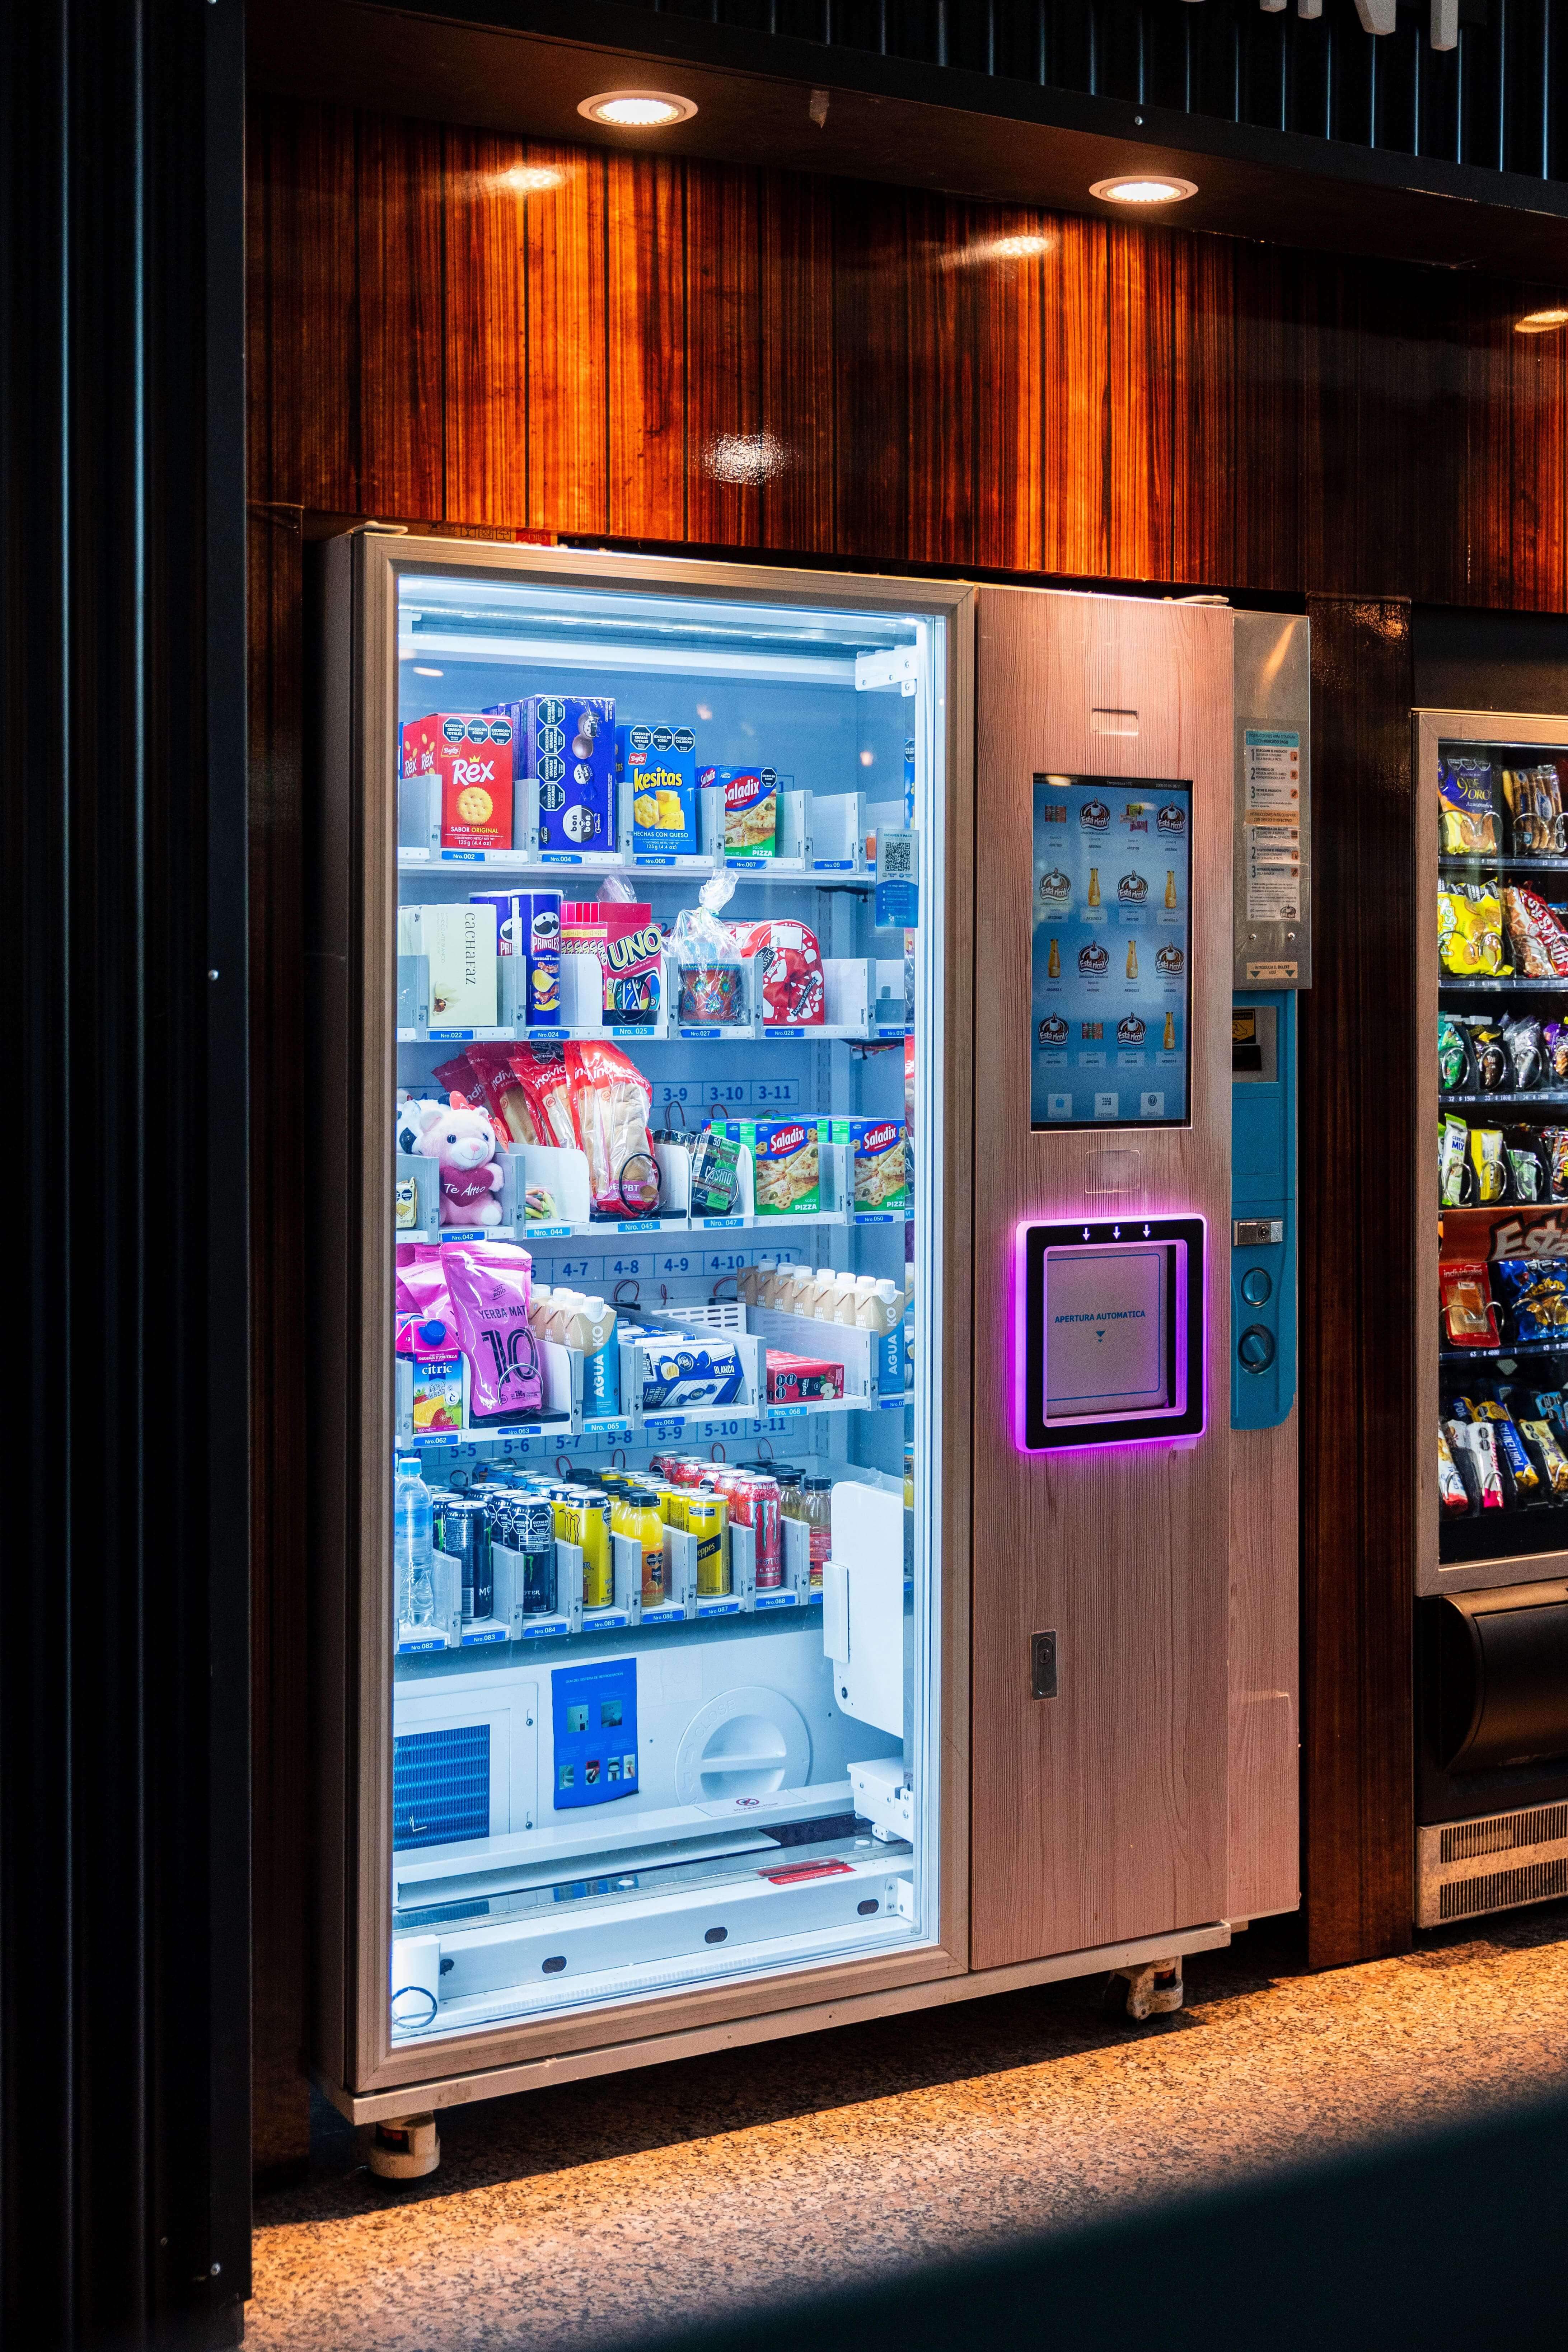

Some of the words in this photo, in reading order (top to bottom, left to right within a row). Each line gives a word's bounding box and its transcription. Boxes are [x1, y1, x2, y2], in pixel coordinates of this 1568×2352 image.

[444, 747, 459, 755] Bagley
[1251, 748, 1254, 761] 1
[405, 758, 417, 777] Rex
[421, 752, 434, 770] Rex
[452, 759, 495, 786] Rex
[701, 770, 716, 787] Saladix
[1251, 767, 1255, 780] 2
[634, 767, 682, 793] kesitas
[1468, 779, 1479, 788] DE
[725, 779, 760, 804] Saladix
[1251, 786, 1255, 799] 3
[1457, 778, 1468, 799] 9
[1468, 789, 1490, 800] ORO
[1081, 816, 1094, 825] Está
[1094, 817, 1107, 827] rico!
[1158, 820, 1171, 828] Está
[1170, 821, 1184, 830] rico!
[1252, 828, 1255, 841] 1
[1251, 846, 1256, 859] 2
[1252, 865, 1256, 879] 3
[1041, 886, 1054, 896] Está
[1054, 888, 1068, 897] rico!
[1119, 889, 1132, 897] Está
[1132, 890, 1144, 899] rico!
[533, 936, 560, 951] PRINGLES
[607, 925, 661, 972] UNO
[597, 940, 607, 965] UNO
[767, 961, 782, 978] Billiken
[1080, 959, 1092, 969] Está
[1092, 960, 1106, 970] rico!
[1156, 960, 1169, 968] Está
[1169, 960, 1182, 969] rico!
[794, 999, 805, 1015] SABORES
[804, 978, 817, 999] FRUTALES
[1040, 1032, 1053, 1041] Está
[1053, 1032, 1066, 1041] rico!
[1118, 1032, 1130, 1040] Está
[1130, 1032, 1143, 1041] rico!
[663, 1087, 688, 1102] 3-9
[710, 1086, 744, 1101] 3-10
[758, 1085, 790, 1100] 3-11
[771, 1127, 805, 1152] Saladix
[864, 1125, 897, 1149] Saladix
[1452, 1140, 1465, 1152] MIX
[444, 1183, 459, 1194] Te
[562, 1262, 589, 1276] 4-7
[613, 1260, 639, 1274] 4-8
[664, 1257, 689, 1271] 4-9
[711, 1255, 745, 1269] 4-10
[1443, 1265, 1483, 1278] individuales
[493, 1288, 506, 1298] ROJO
[478, 1308, 508, 1320] YERBA
[886, 1307, 897, 1327] KO
[1054, 1313, 1095, 1324] APERTURA
[1096, 1309, 1146, 1321] AUTOMATICA
[592, 1325, 604, 1346] KO
[481, 1327, 537, 1384] 10
[888, 1334, 898, 1375] AGUA
[422, 1362, 452, 1375] citric
[713, 1365, 735, 1374] BLANCO
[593, 1354, 604, 1398] AGUA
[704, 1420, 738, 1436] 5-10
[556, 1434, 580, 1449] 5-7
[607, 1430, 632, 1444] 5-8
[450, 1443, 477, 1458] 5-5
[504, 1438, 529, 1454] 5-6
[765, 1597, 786, 1605] Nro.088
[708, 1606, 728, 1615] Nro.087
[474, 1634, 495, 1642] Nro.083
[411, 1642, 433, 1651] Nro.082
[694, 1699, 737, 1739] CLOSE
